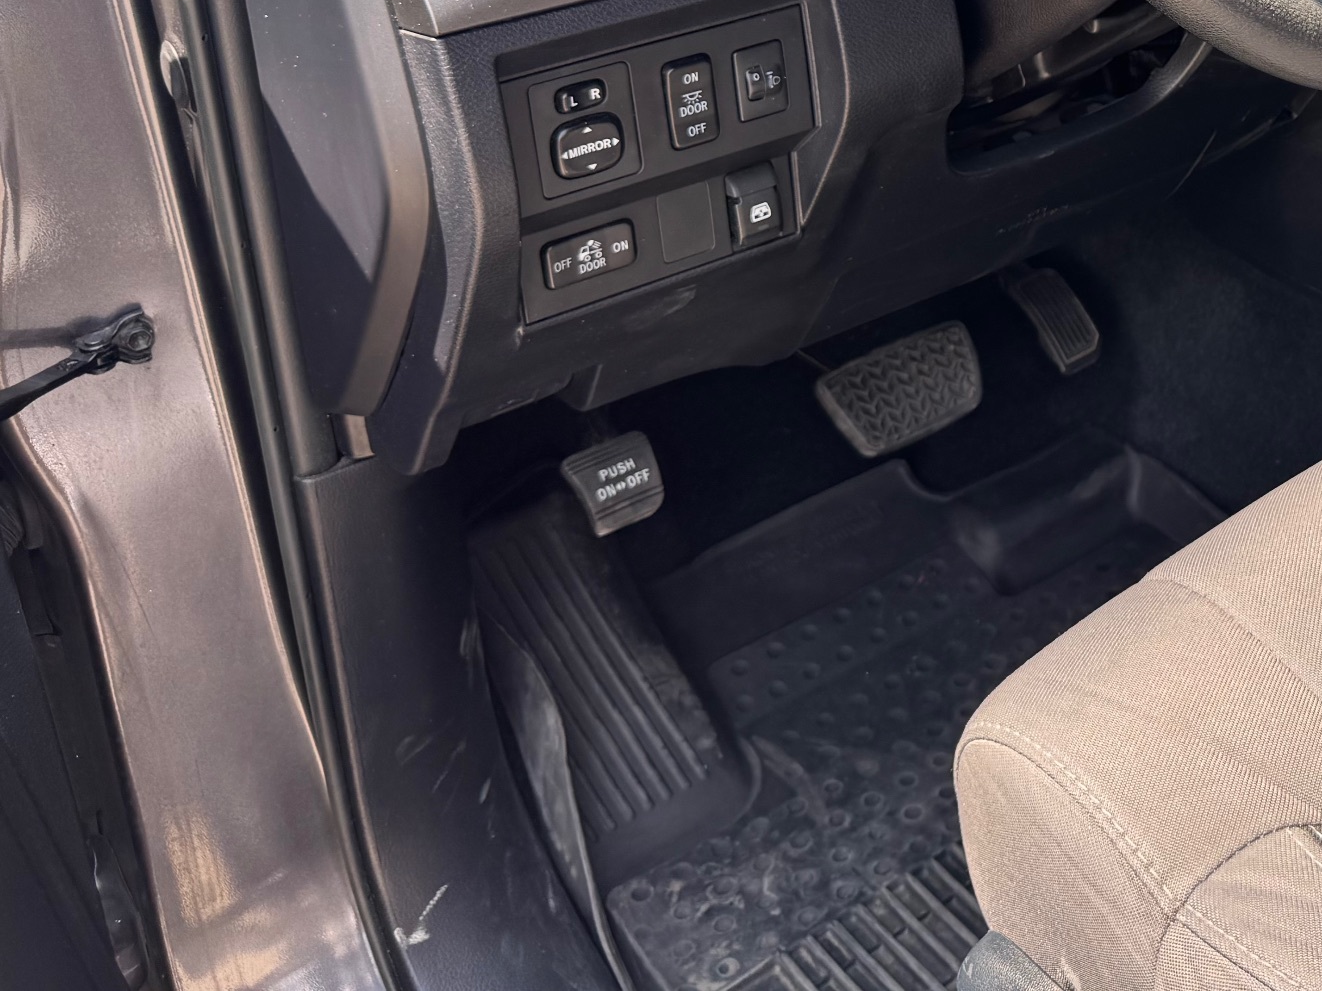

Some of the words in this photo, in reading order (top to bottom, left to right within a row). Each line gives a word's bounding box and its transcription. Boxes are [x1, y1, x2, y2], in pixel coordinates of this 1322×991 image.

[683, 71, 699, 85] ON
[570, 95, 579, 108] L
[589, 88, 602, 101] R
[679, 100, 708, 118] DOOR
[687, 122, 707, 139] OFF
[568, 138, 613, 160] MIRROR
[553, 257, 573, 274] OFF
[612, 240, 630, 254] ON
[578, 256, 607, 276] DOOR
[598, 457, 636, 482] PUSH
